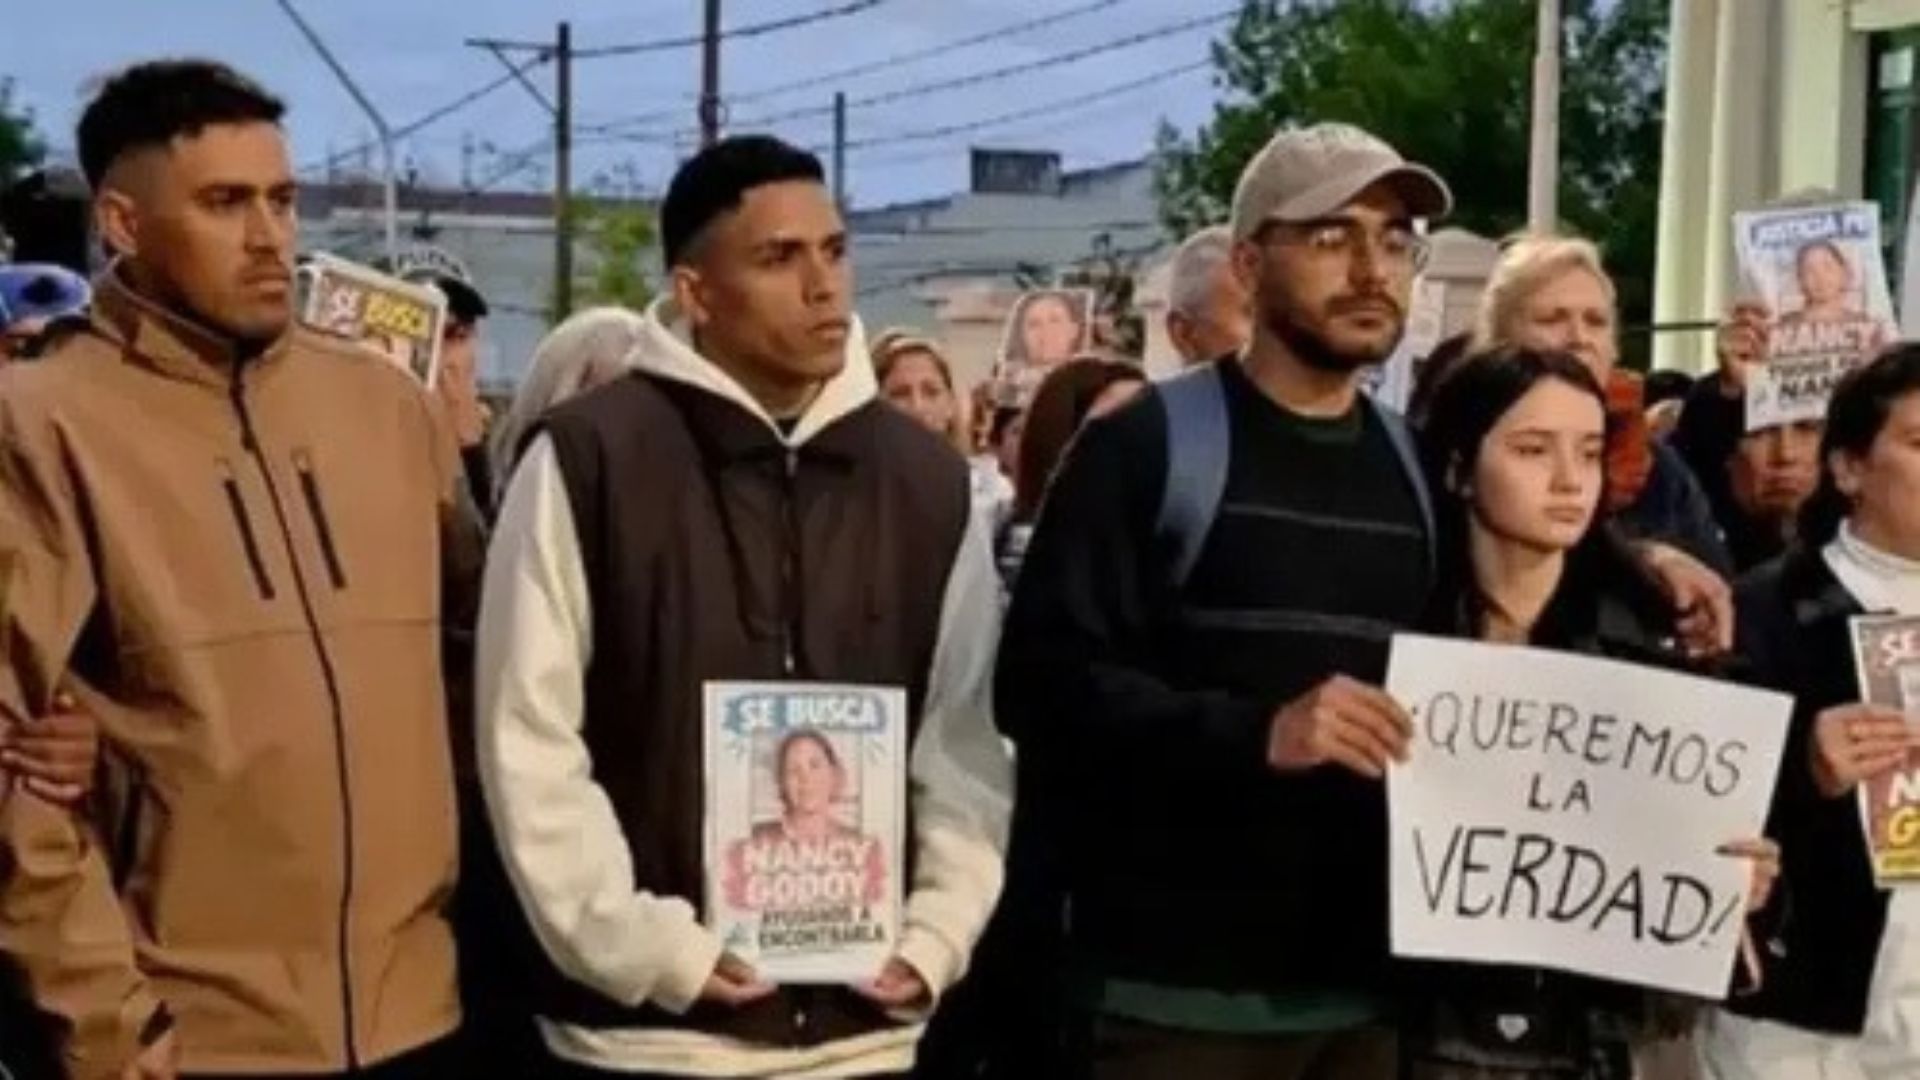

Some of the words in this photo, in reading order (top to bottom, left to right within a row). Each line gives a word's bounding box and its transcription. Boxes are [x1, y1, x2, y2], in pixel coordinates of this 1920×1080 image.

[1768, 321, 1876, 356] NANCY
[1779, 375, 1838, 399] NAN
[738, 698, 775, 732] SE
[785, 696, 880, 731] BUSCA
[1412, 691, 1748, 797] QUEREMOS
[1527, 772, 1592, 813] LA
[743, 837, 875, 876] NANCY
[745, 873, 868, 904] GODOY
[1412, 825, 1740, 947] VERDAD!
